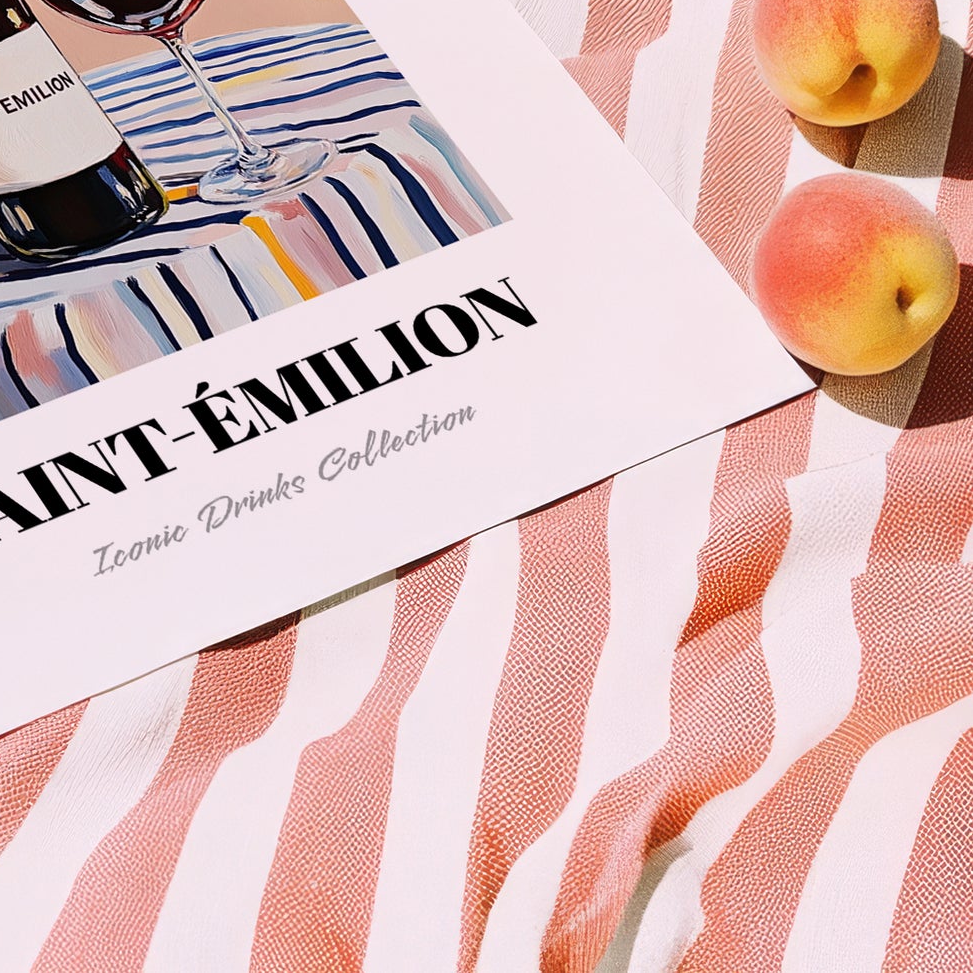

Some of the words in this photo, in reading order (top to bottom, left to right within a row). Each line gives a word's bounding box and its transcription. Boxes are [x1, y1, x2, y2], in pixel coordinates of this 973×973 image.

[93, 524, 189, 576] Iconic
[197, 472, 306, 532] Drinks
[318, 404, 477, 481] Collection
